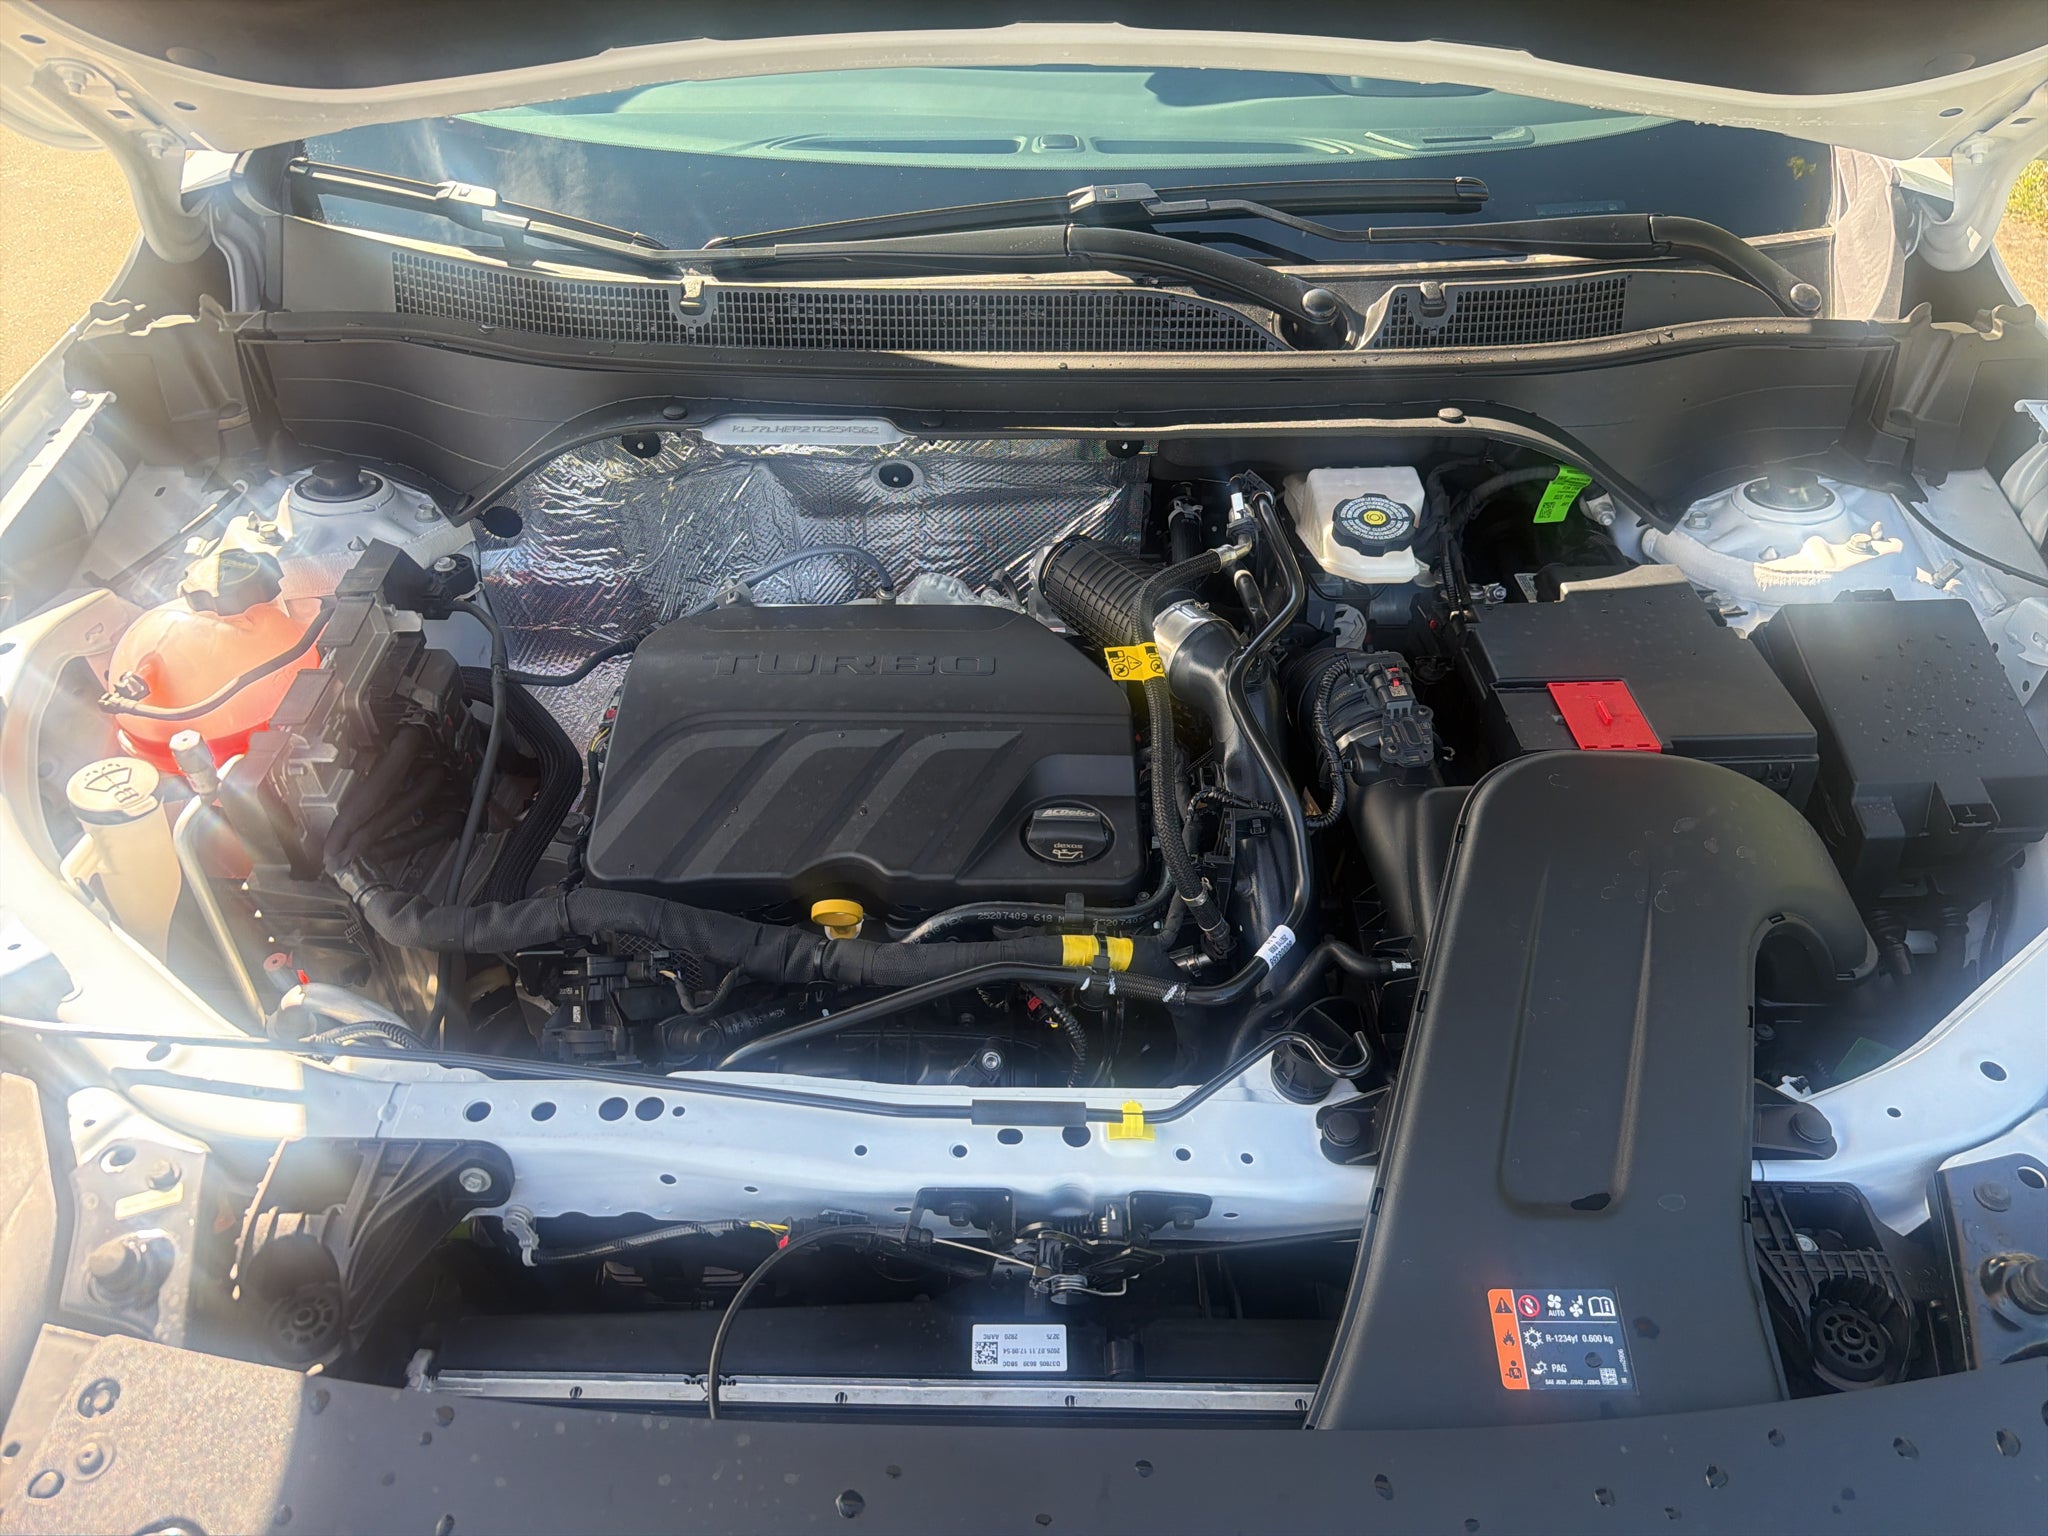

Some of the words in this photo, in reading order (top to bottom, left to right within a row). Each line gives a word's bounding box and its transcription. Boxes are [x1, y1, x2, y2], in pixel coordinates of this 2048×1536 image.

[732, 425, 880, 434] KL77LHEP2TC254562
[701, 653, 997, 677] TURBO
[1041, 809, 1096, 817] ACDelco
[1545, 1334, 1578, 1345] R-1234yf
[1581, 1334, 1603, 1343] 0.600
[1603, 1334, 1614, 1345] kg
[1551, 1363, 1568, 1373] PAG
